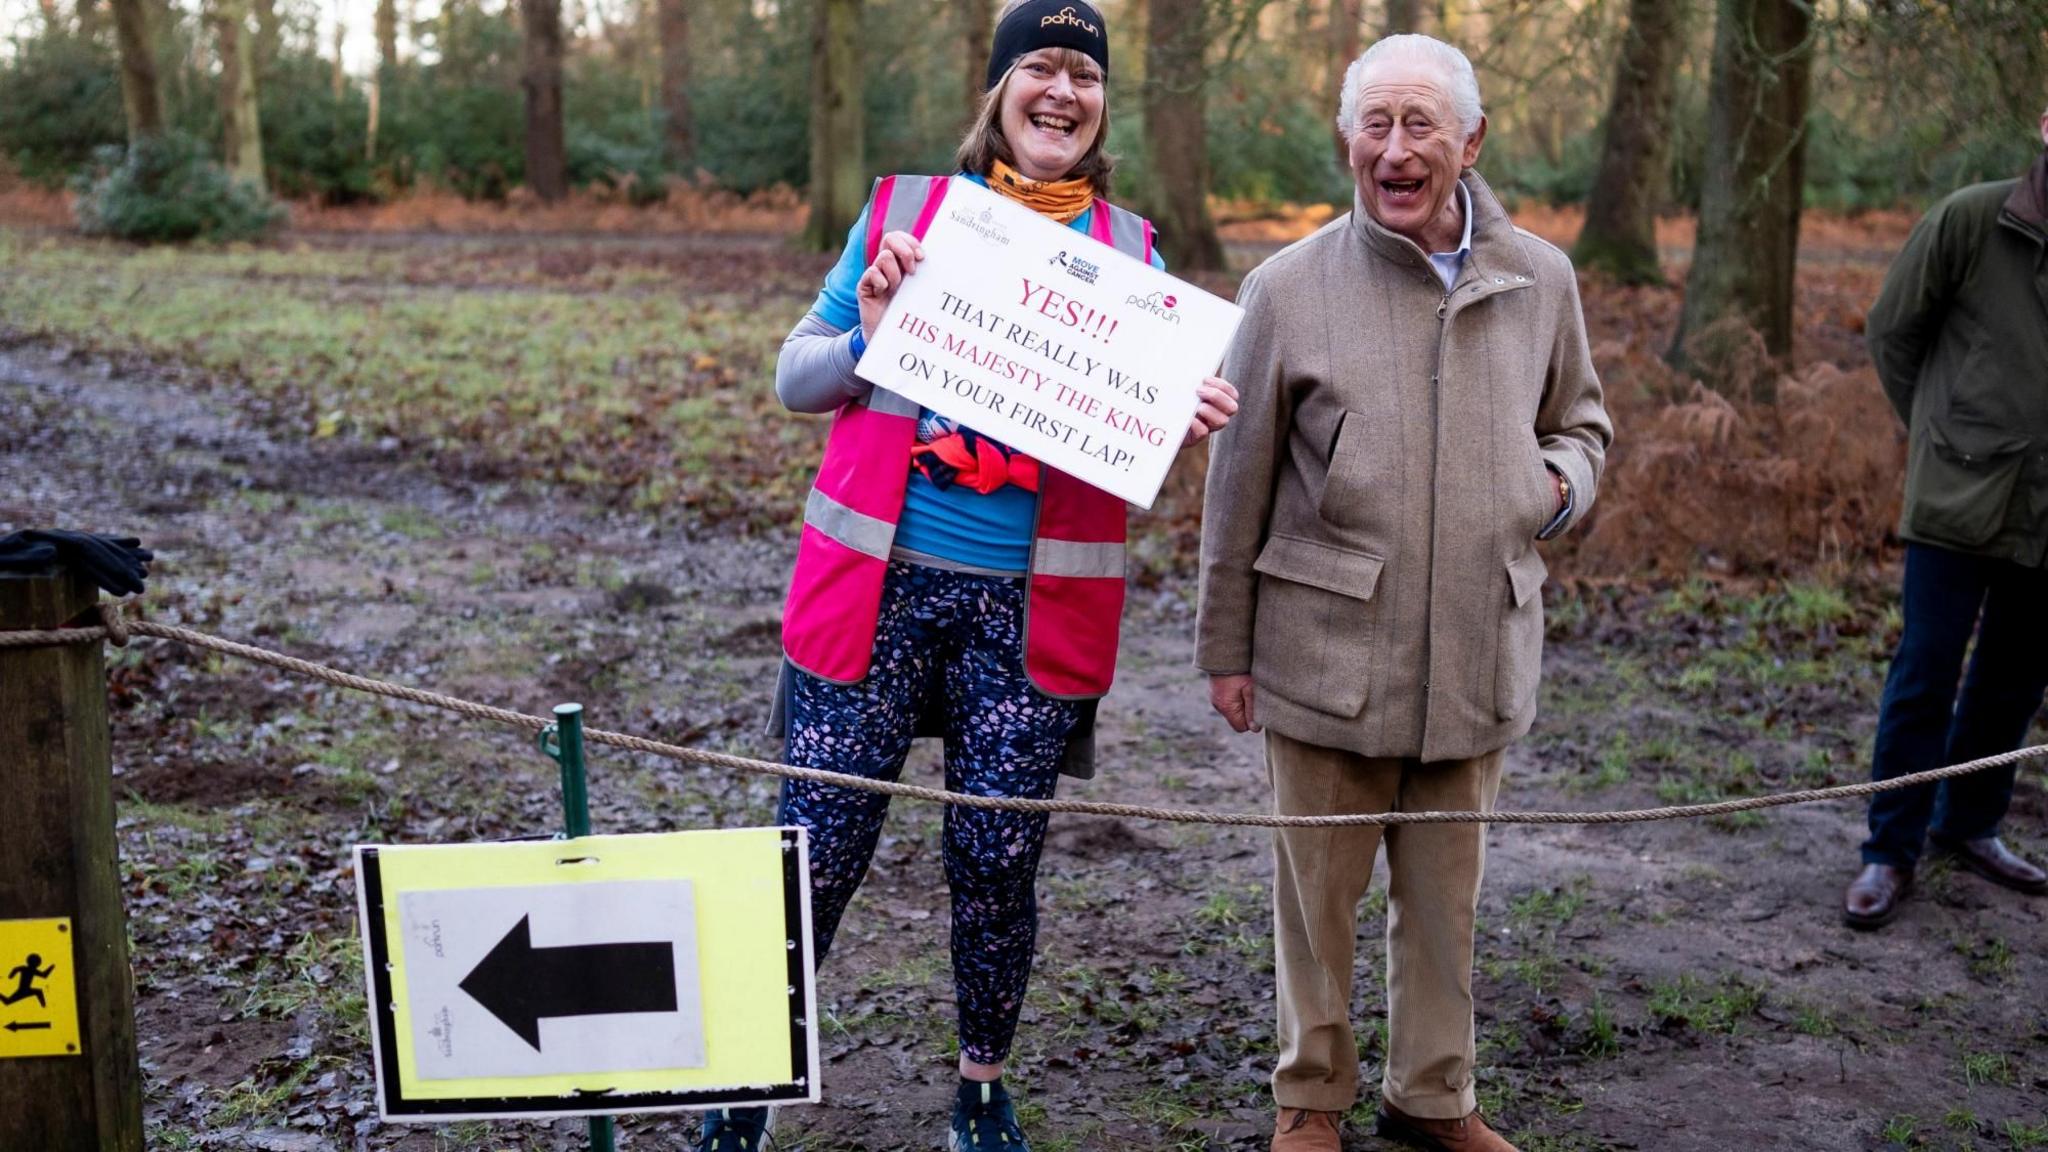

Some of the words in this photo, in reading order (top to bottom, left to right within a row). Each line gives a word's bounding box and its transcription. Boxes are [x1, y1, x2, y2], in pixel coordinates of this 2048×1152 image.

[1041, 6, 1099, 38] parkrun
[950, 210, 1010, 246] Sandringham
[1068, 264, 1099, 279] AGAINST
[1072, 256, 1100, 272] MOVE
[1019, 278, 1119, 344] YES!!!
[1125, 291, 1181, 325] parkrun
[940, 291, 1004, 333] THAT
[1006, 323, 1102, 377] REALLY
[1108, 367, 1159, 405] WAS
[898, 312, 939, 344] HIS
[942, 332, 1050, 391] MAJESTY
[1055, 382, 1099, 418] THE
[1104, 408, 1167, 447] KING
[899, 352, 936, 381] ON
[941, 369, 1005, 413] YOUR
[1010, 402, 1078, 446] FIRST
[1080, 435, 1135, 472] LAP!
